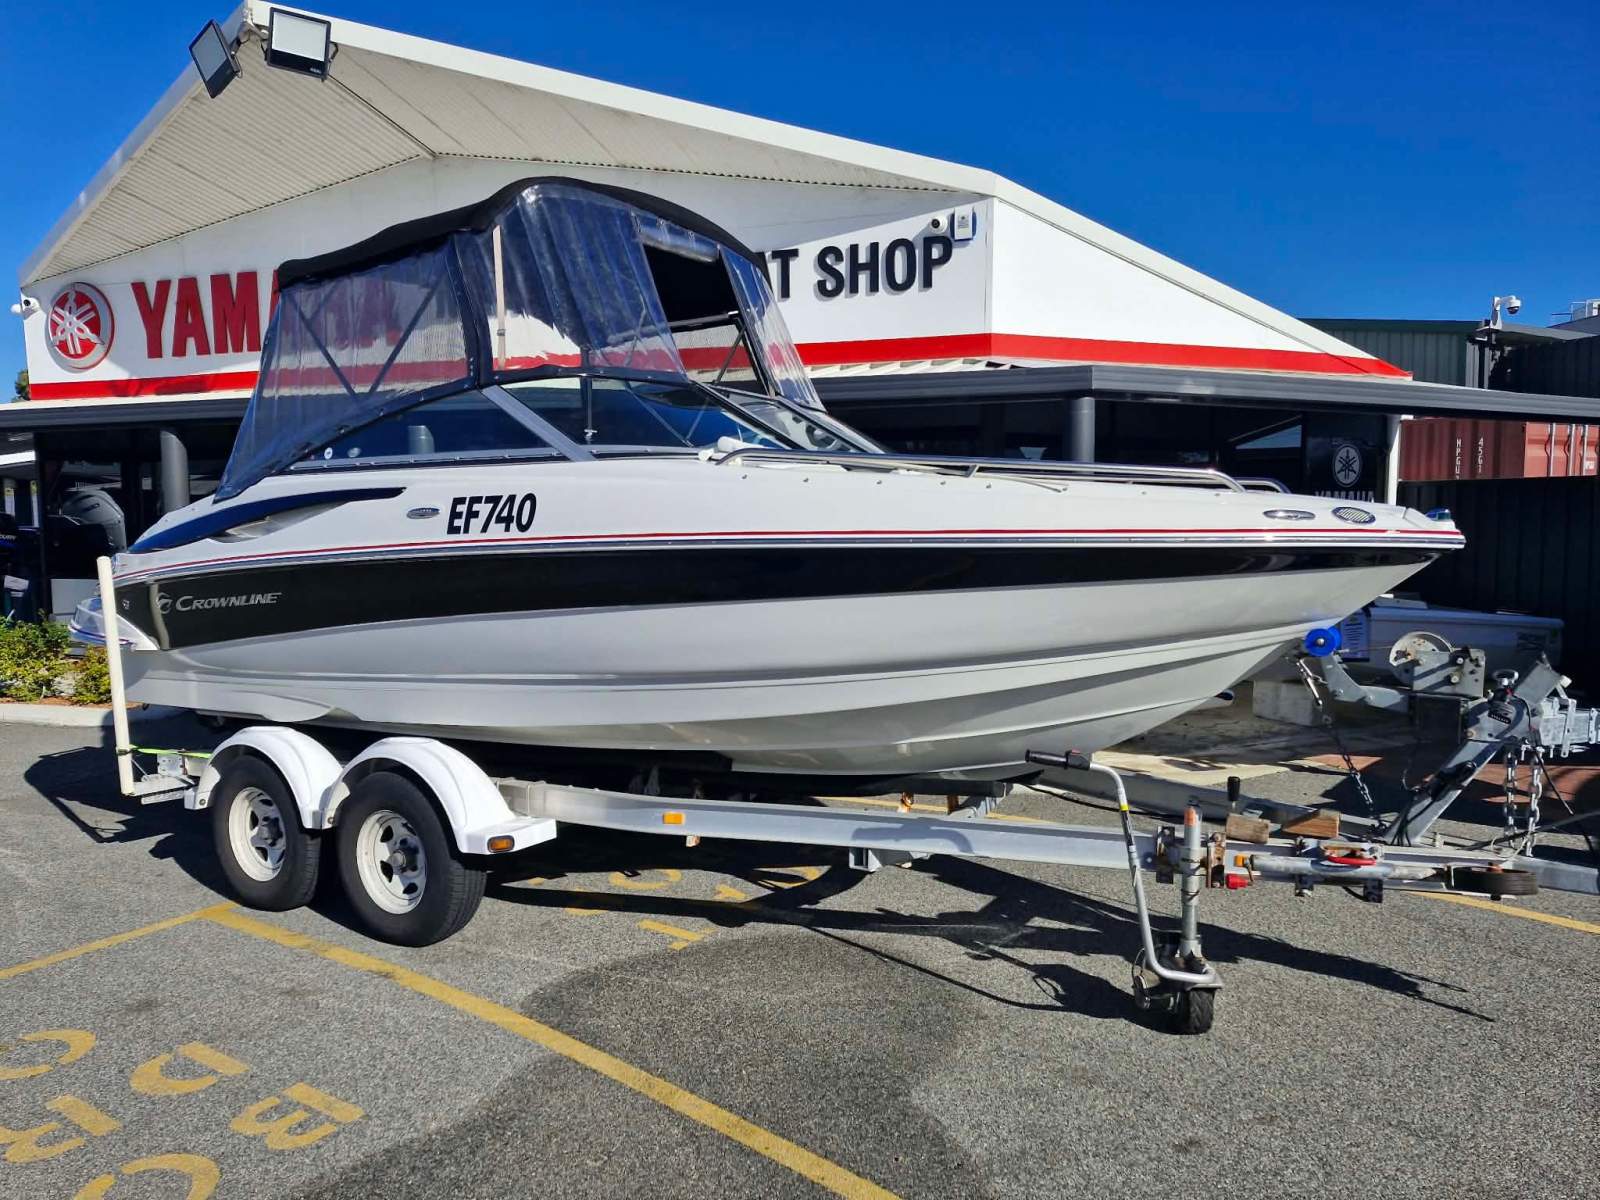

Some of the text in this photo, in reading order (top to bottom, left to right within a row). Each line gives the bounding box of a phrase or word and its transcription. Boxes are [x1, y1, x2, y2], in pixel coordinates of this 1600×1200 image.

[817, 235, 953, 298] SHOP
[131, 269, 279, 359] YAM
[447, 492, 537, 535] EF740
[175, 592, 282, 612] CROWNLINE
